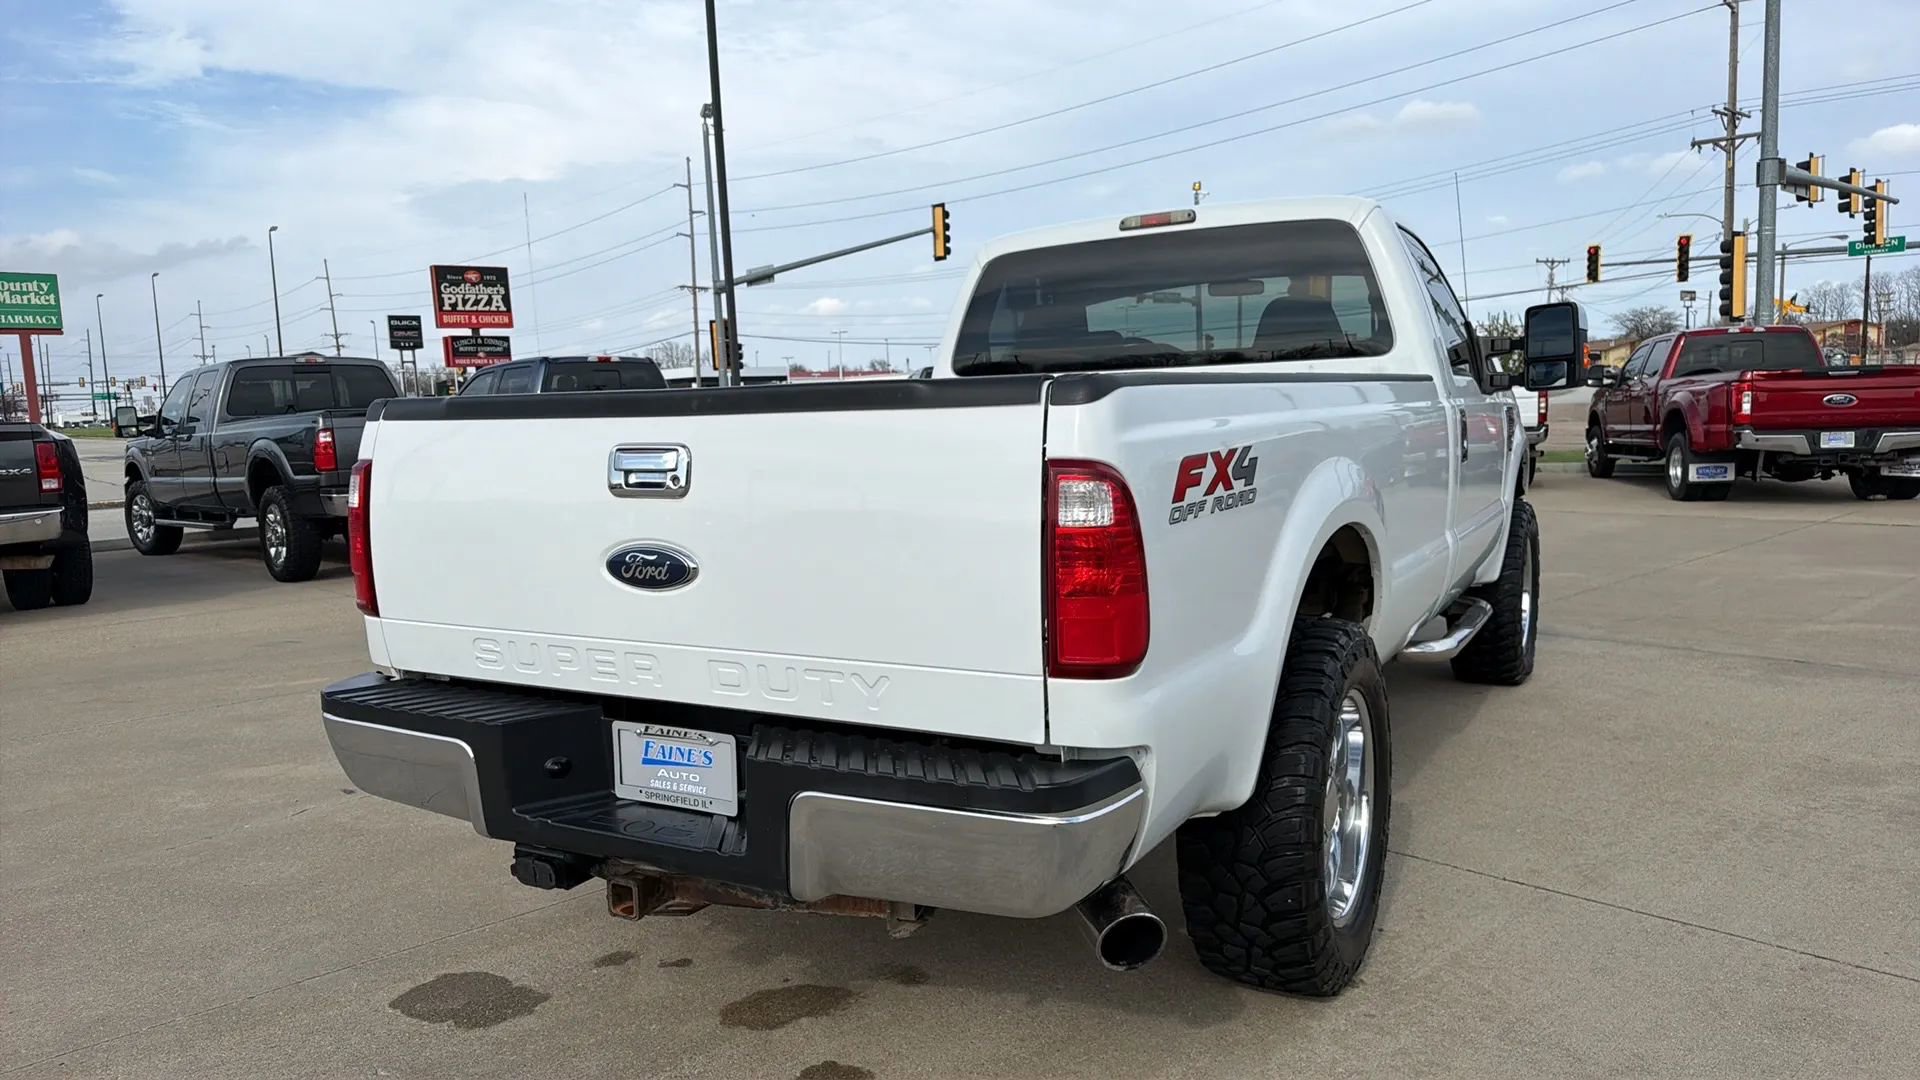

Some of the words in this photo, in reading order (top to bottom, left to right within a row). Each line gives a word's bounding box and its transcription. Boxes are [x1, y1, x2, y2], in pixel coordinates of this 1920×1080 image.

[440, 282, 506, 295] Godfather's
[441, 294, 507, 311] PIZZA
[442, 315, 469, 324] BUFFET
[470, 315, 478, 324] &
[478, 315, 509, 324] CHICKEN
[453, 338, 476, 348] LUNCH
[484, 338, 508, 348] DINNER
[1171, 445, 1258, 505] FX4
[1168, 499, 1207, 526] OFF
[1210, 487, 1257, 514] ROAD
[621, 552, 670, 580] Ford
[472, 637, 664, 688] SUPER
[707, 659, 891, 711] DUTY
[643, 740, 713, 765] FAINE'S
[657, 768, 700, 782] AUTO
[650, 778, 671, 789] SALES
[672, 782, 678, 790] &
[679, 782, 707, 795] SERVICE
[644, 791, 700, 808] SPRINGFIELD
[701, 800, 709, 809] IL
